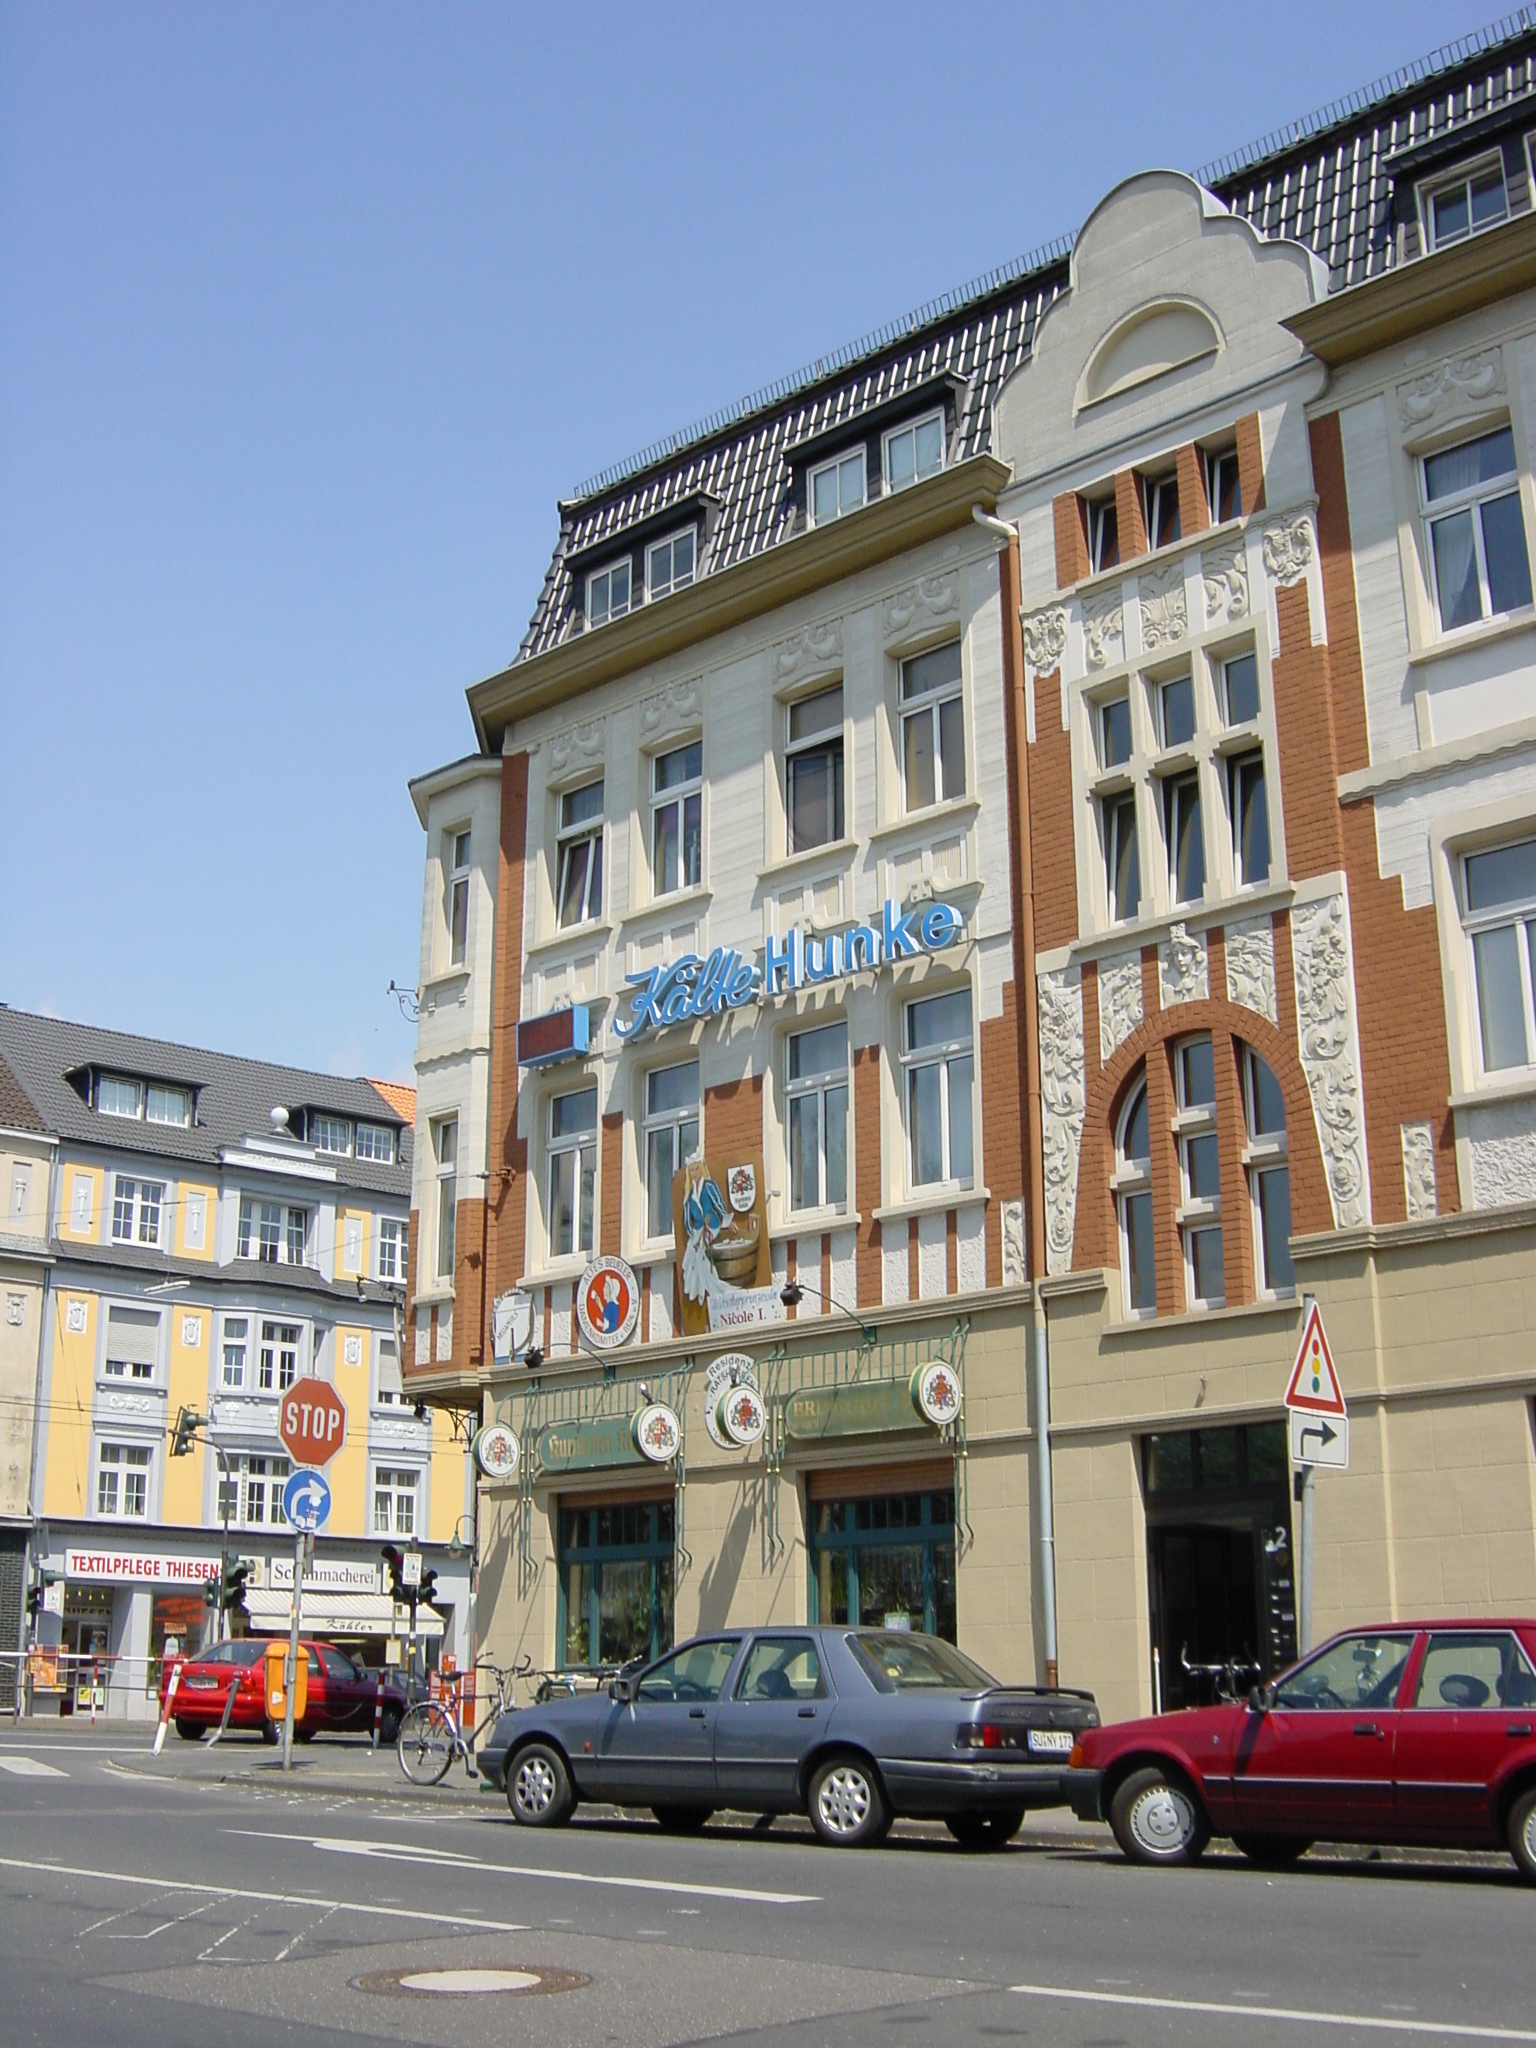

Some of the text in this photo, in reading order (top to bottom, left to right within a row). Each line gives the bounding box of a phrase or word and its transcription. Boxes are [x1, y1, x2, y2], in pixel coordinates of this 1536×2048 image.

[612, 946, 762, 1040] Kälte
[766, 898, 962, 995] Hunke
[584, 1259, 604, 1286] ALTES
[720, 1310, 754, 1326] Nicole
[708, 1355, 751, 1378] Residenz
[285, 1401, 340, 1442] STOP
[1275, 1526, 1287, 1548] 2
[72, 1555, 219, 1579] TEXTILPFLEGE THIESEN
